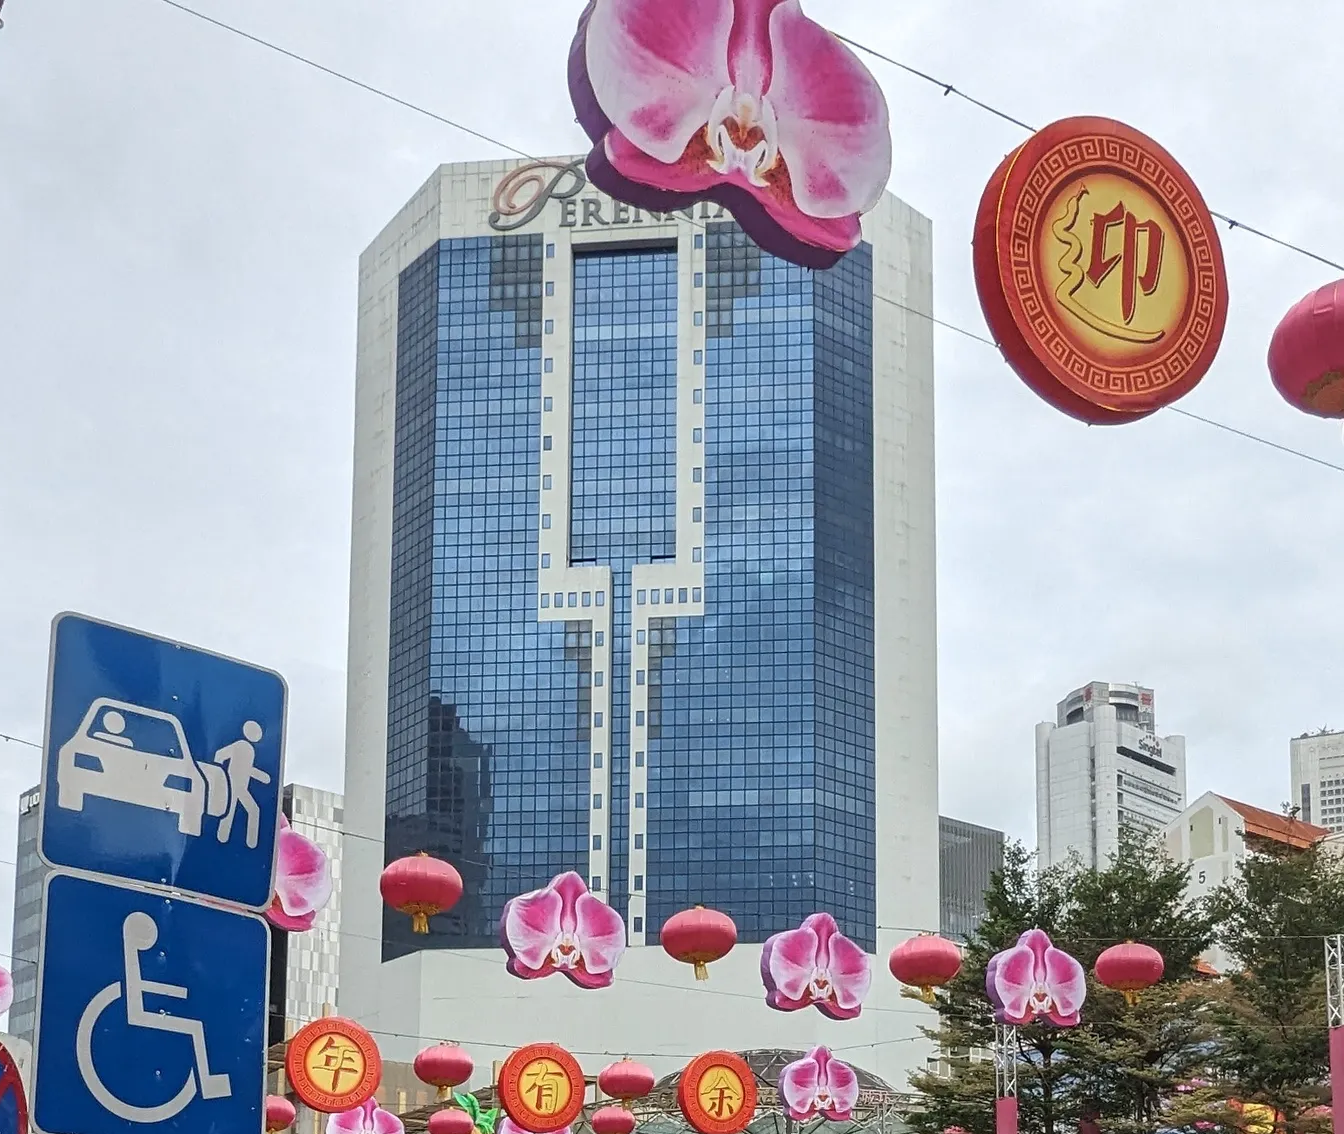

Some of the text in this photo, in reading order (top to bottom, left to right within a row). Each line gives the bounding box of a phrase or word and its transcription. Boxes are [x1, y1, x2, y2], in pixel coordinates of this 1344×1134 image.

[1198, 870, 1206, 885] 5
[312, 1036, 359, 1092] 年
[526, 1062, 564, 1115] 有
[701, 1070, 741, 1117] 余
